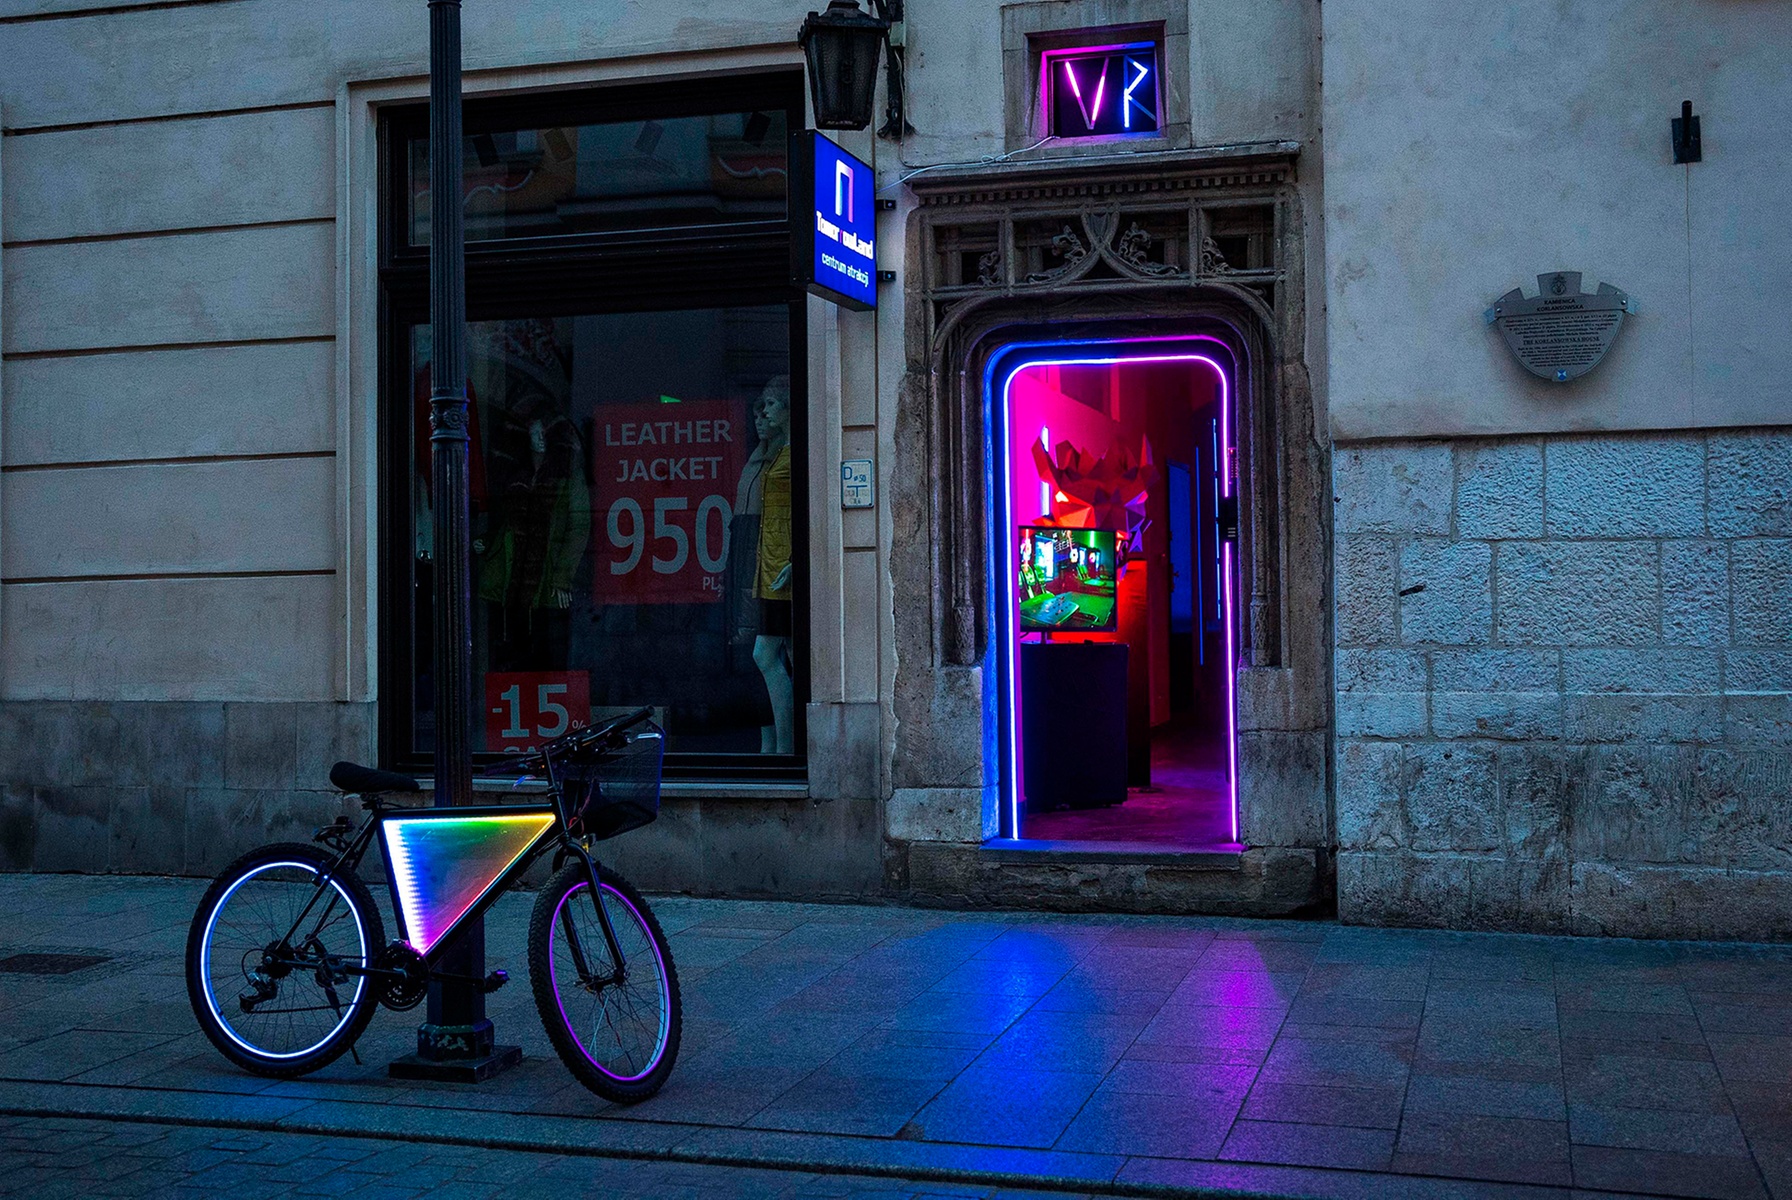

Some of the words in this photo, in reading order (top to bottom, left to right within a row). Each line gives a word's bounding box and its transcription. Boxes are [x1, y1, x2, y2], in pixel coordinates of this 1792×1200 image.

[1063, 55, 1157, 130] VR
[821, 252, 847, 275] centrum
[847, 263, 869, 288] atrakcji
[605, 419, 733, 447] LEATHER
[616, 456, 723, 483] JACKET
[606, 494, 733, 576] 950
